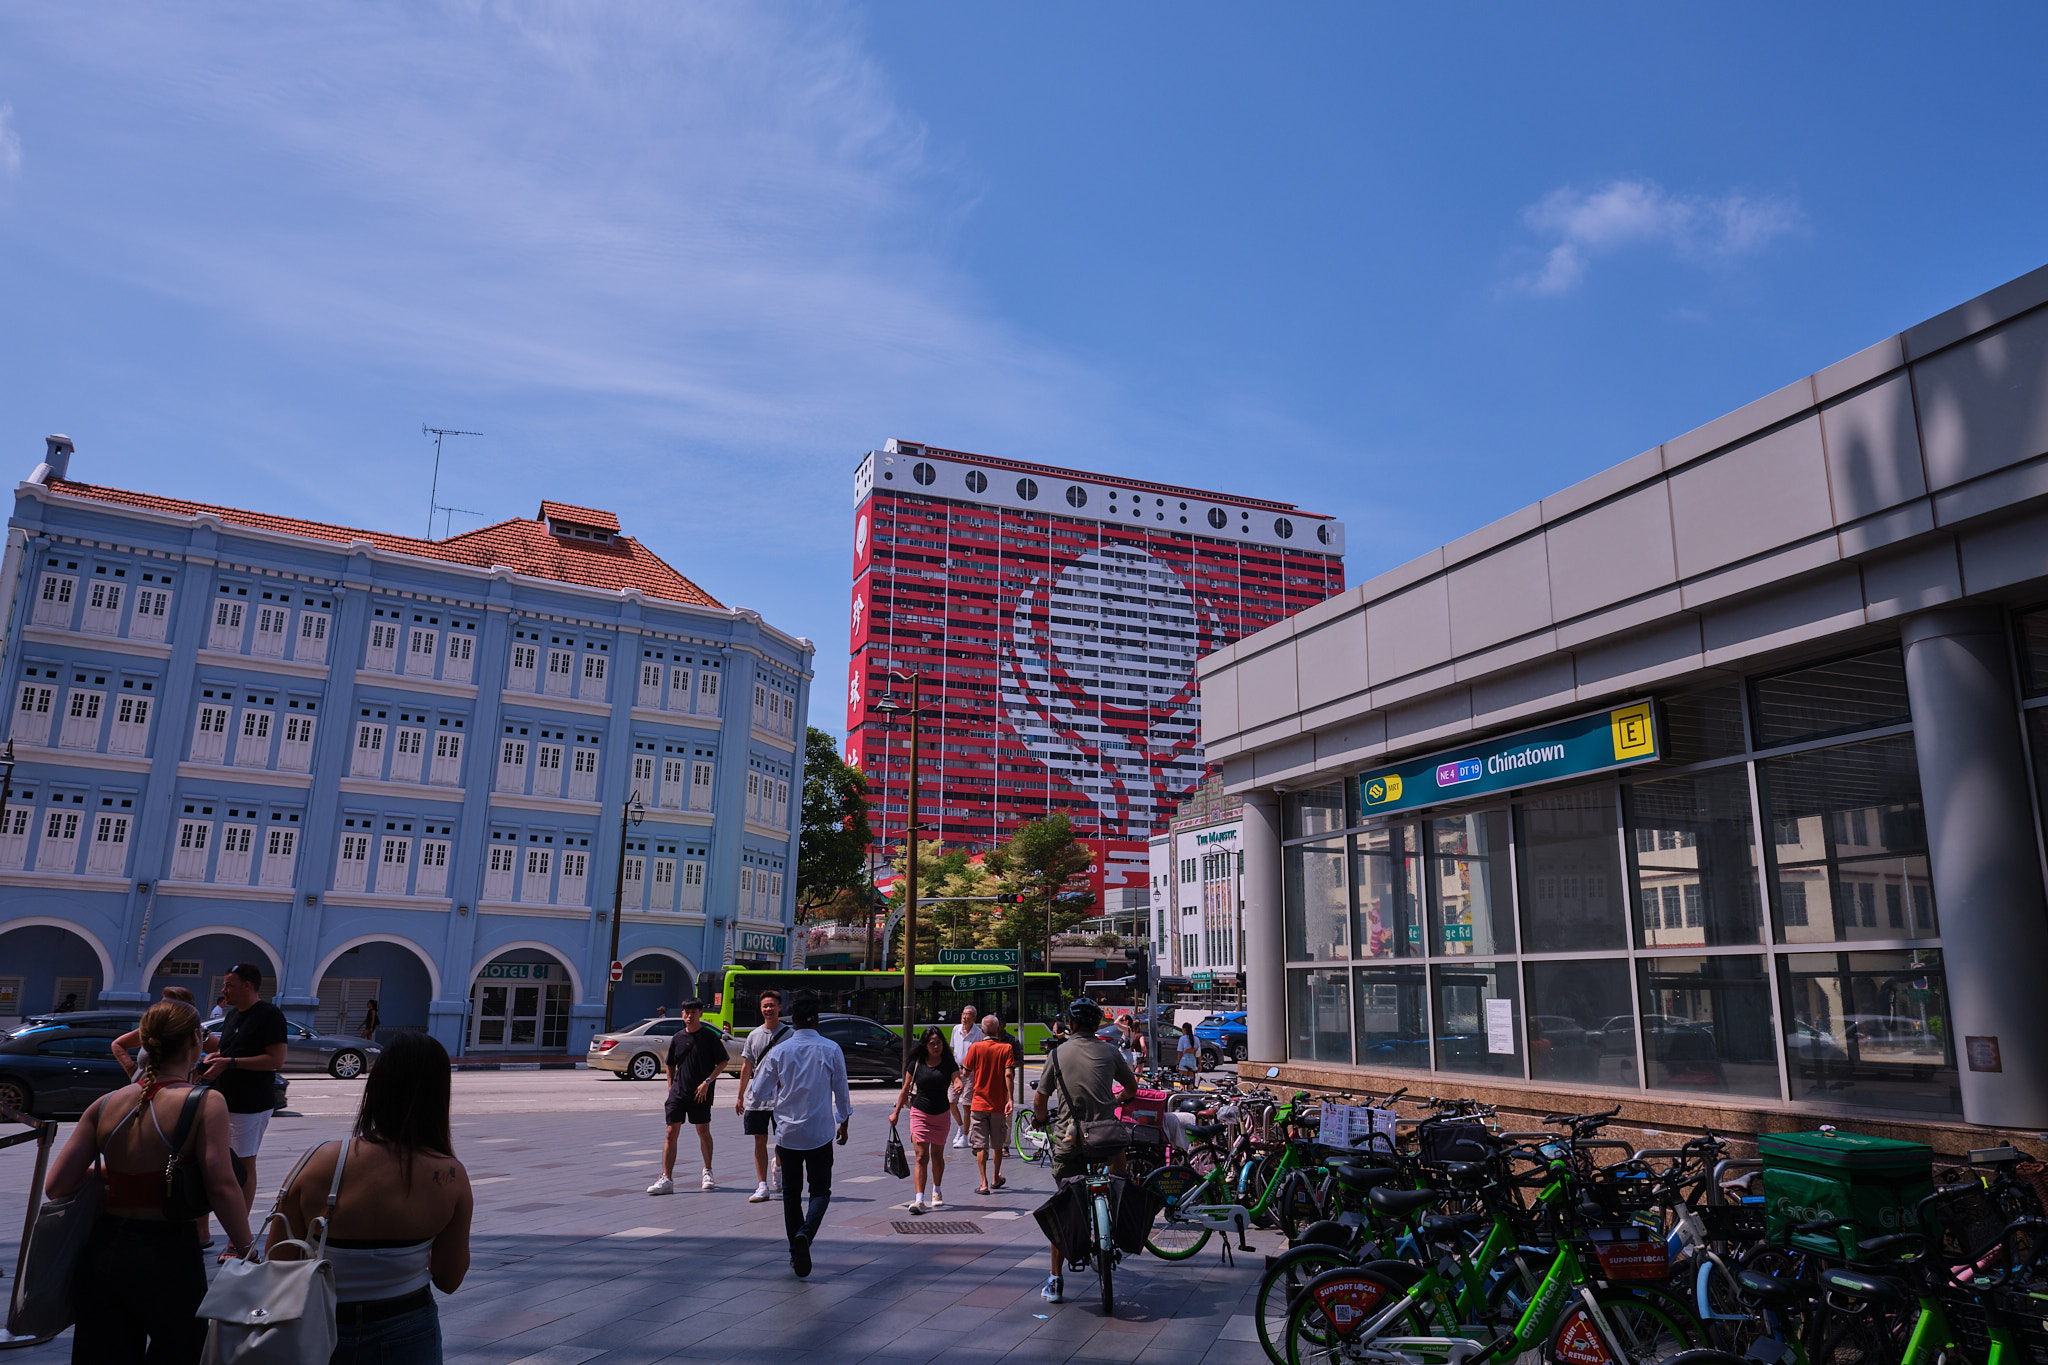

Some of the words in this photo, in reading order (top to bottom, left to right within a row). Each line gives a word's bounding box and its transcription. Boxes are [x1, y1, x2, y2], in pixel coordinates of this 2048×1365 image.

[1627, 721, 1638, 742] E
[1440, 771, 1449, 781] NE
[1449, 769, 1455, 779] 4
[1459, 767, 1469, 777] DT
[1470, 764, 1479, 774] 19
[1487, 742, 1565, 775] Chinatown
[1388, 782, 1400, 793] MRT
[746, 933, 775, 951] HOTEL
[944, 951, 966, 963] Upp
[970, 951, 1000, 961] Cross
[1004, 951, 1016, 961] St
[959, 974, 1016, 988] 克罗士街上段
[1608, 1256, 1642, 1264] SUPPORT
[1643, 1255, 1665, 1263] LOCAL
[1319, 1283, 1354, 1297] SUPPORT
[1354, 1283, 1377, 1295] LOCAL
[1522, 1276, 1560, 1339] anywheel
[1440, 1303, 1457, 1334] GREEN
[1564, 1325, 1578, 1346] RENT
[1585, 1331, 1600, 1350] RIDE
[1567, 1350, 1599, 1364] RETURN
